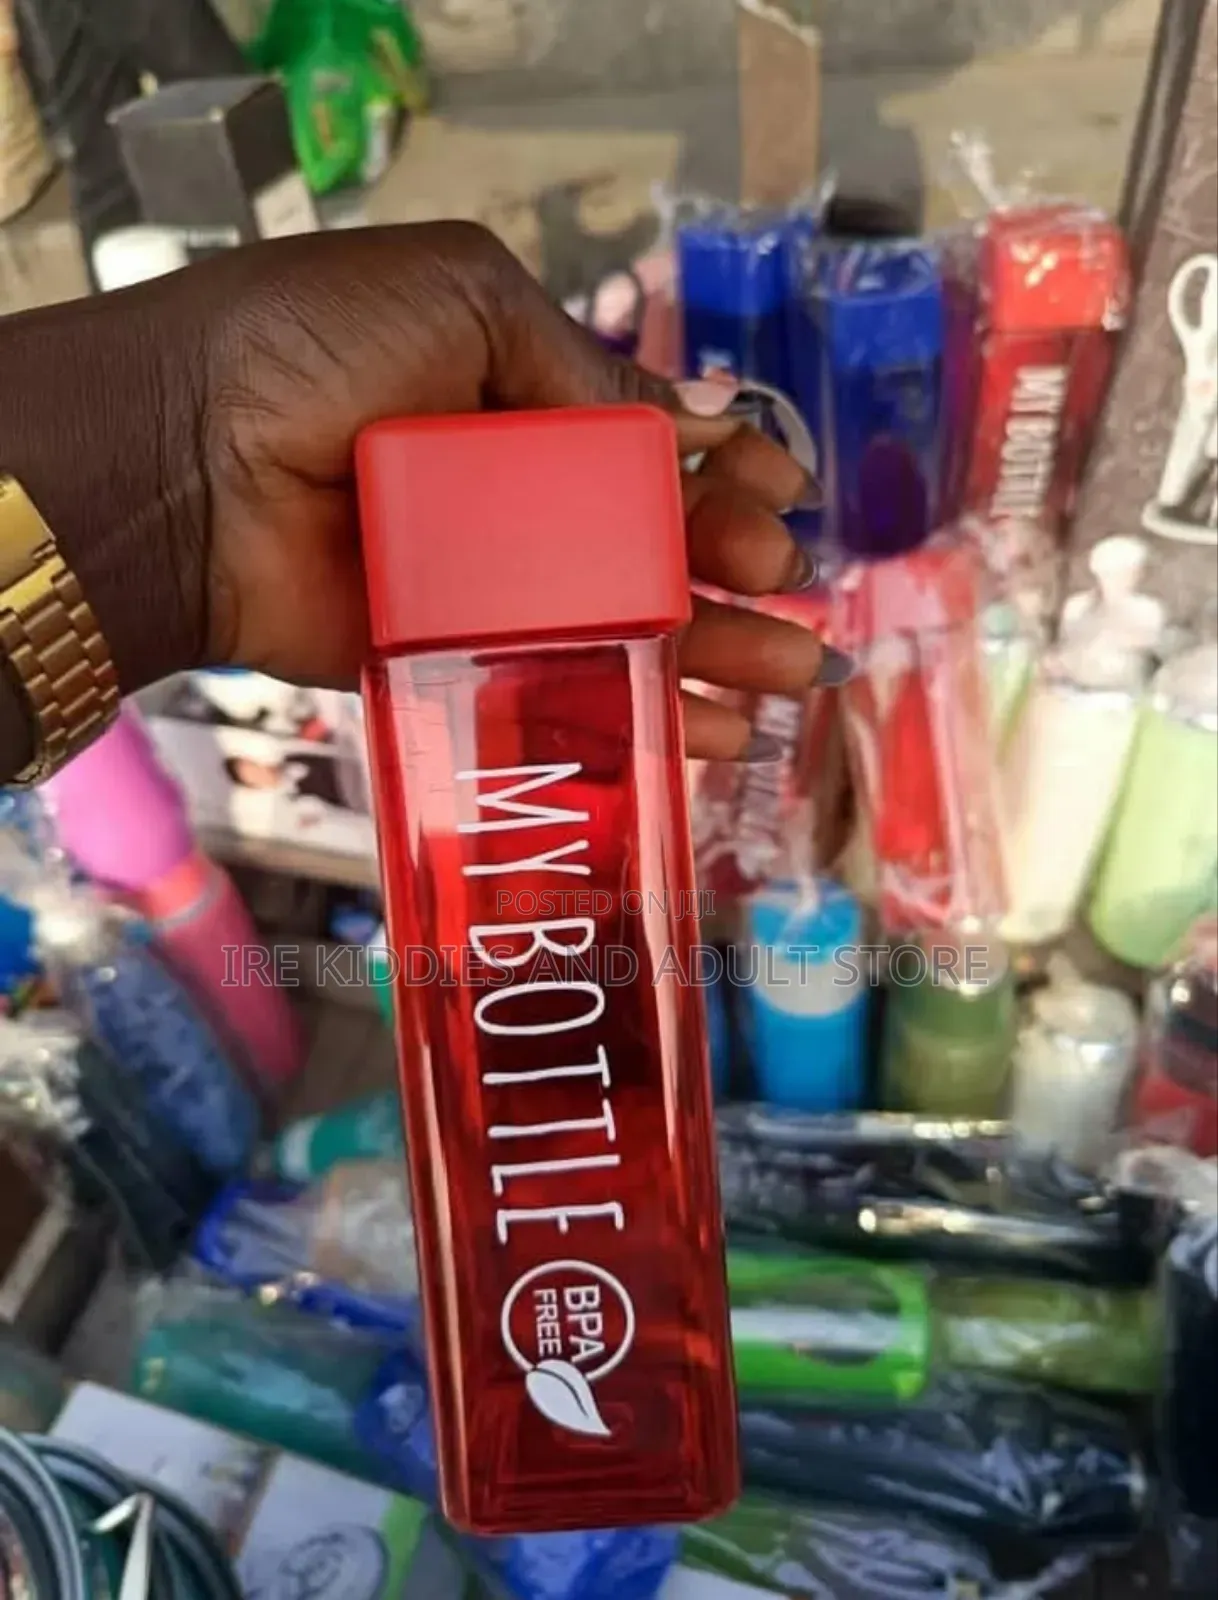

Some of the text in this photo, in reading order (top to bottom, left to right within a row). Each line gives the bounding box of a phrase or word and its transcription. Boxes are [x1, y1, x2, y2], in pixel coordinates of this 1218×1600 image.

[455, 762, 625, 1246] MY BOTTLE
[533, 1288, 562, 1357] FREE
[563, 1284, 605, 1363] BPA
